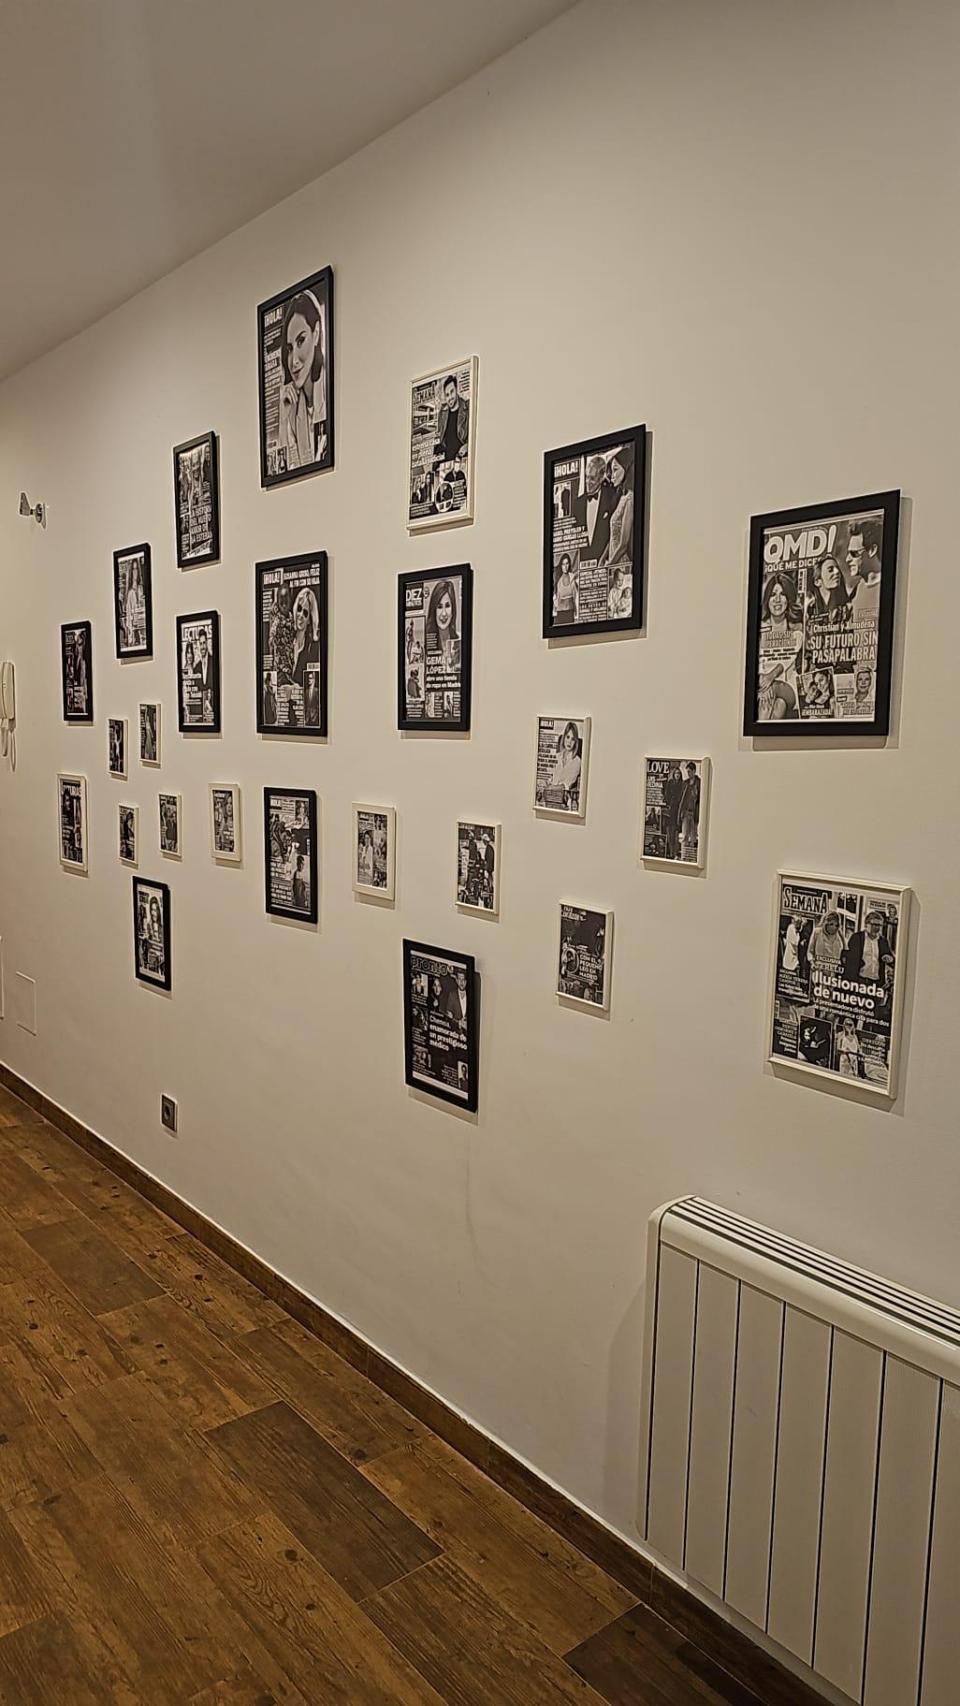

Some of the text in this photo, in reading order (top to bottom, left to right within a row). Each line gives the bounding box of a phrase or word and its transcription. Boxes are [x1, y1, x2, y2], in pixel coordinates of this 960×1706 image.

[554, 461, 579, 478] ¡HOLA!
[764, 525, 837, 562] QMD!
[785, 561, 798, 570] ME
[798, 557, 821, 568] DICE
[825, 633, 860, 649] FUTURO
[863, 631, 878, 646] SIN
[647, 760, 670, 774] LOVE
[783, 887, 828, 914] SEMANA
[812, 970, 885, 998] Ilusionada
[814, 986, 830, 999] de
[832, 990, 875, 1009] nuevo
